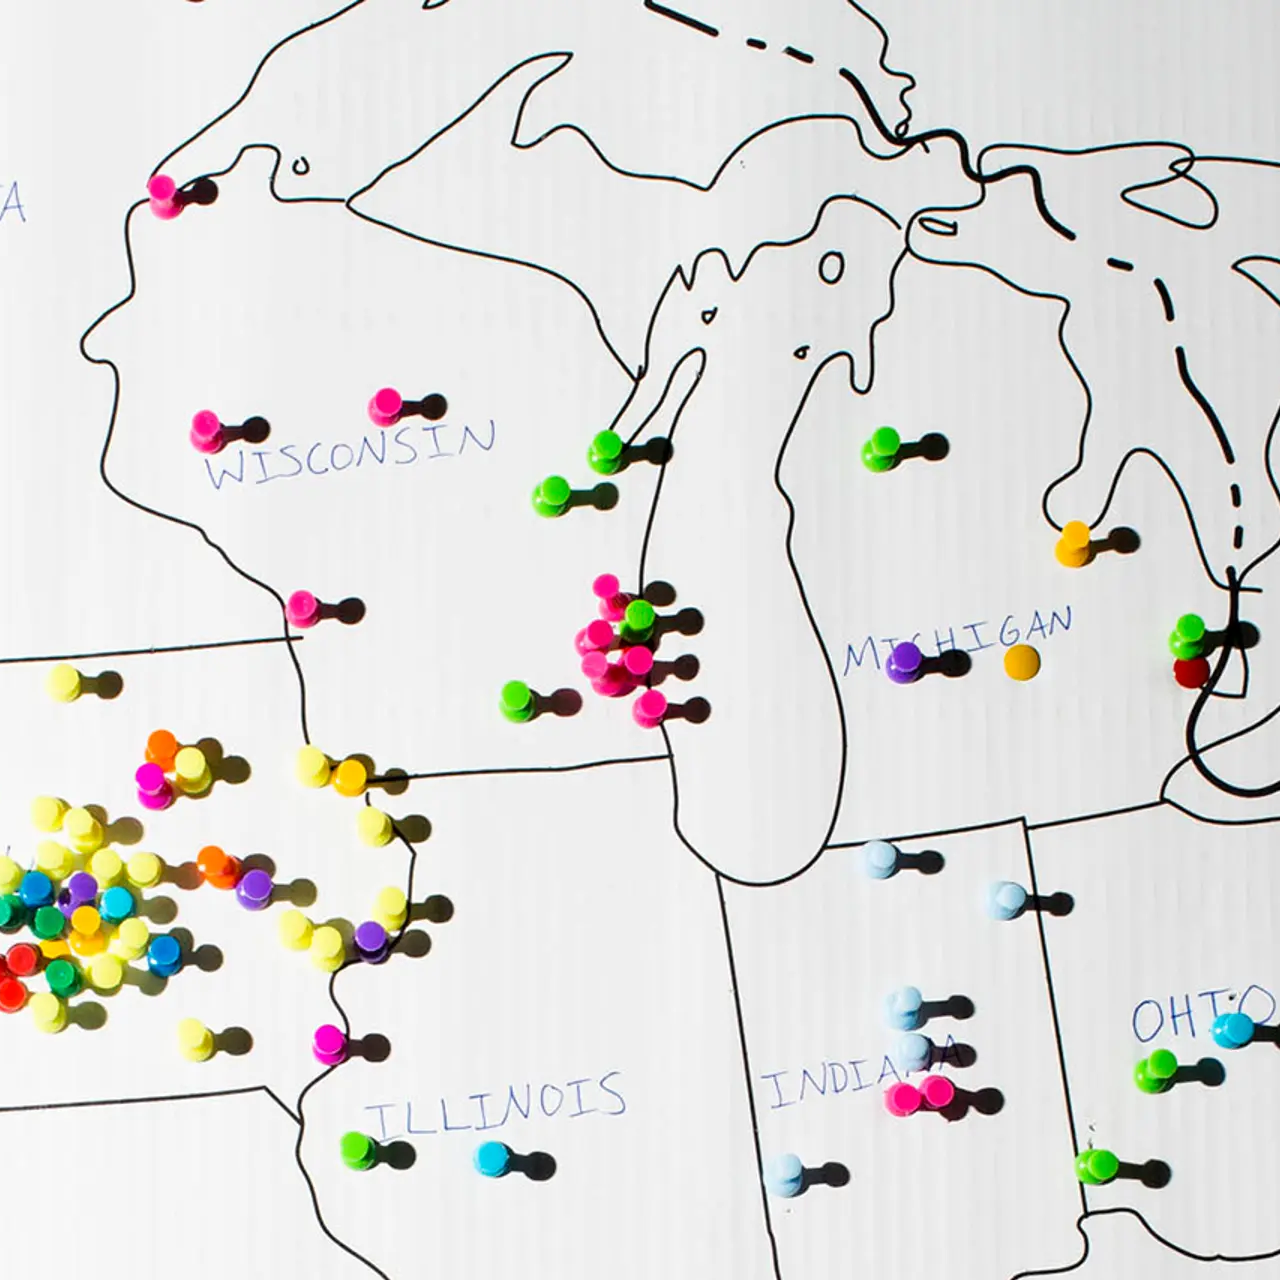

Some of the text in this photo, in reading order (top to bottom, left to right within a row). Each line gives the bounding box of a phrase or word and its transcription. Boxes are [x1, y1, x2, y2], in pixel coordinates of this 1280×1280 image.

[204, 419, 497, 490] WISCONSIN
[364, 1071, 627, 1144] ILLINOIS
[760, 1034, 964, 1109] INDIAA
